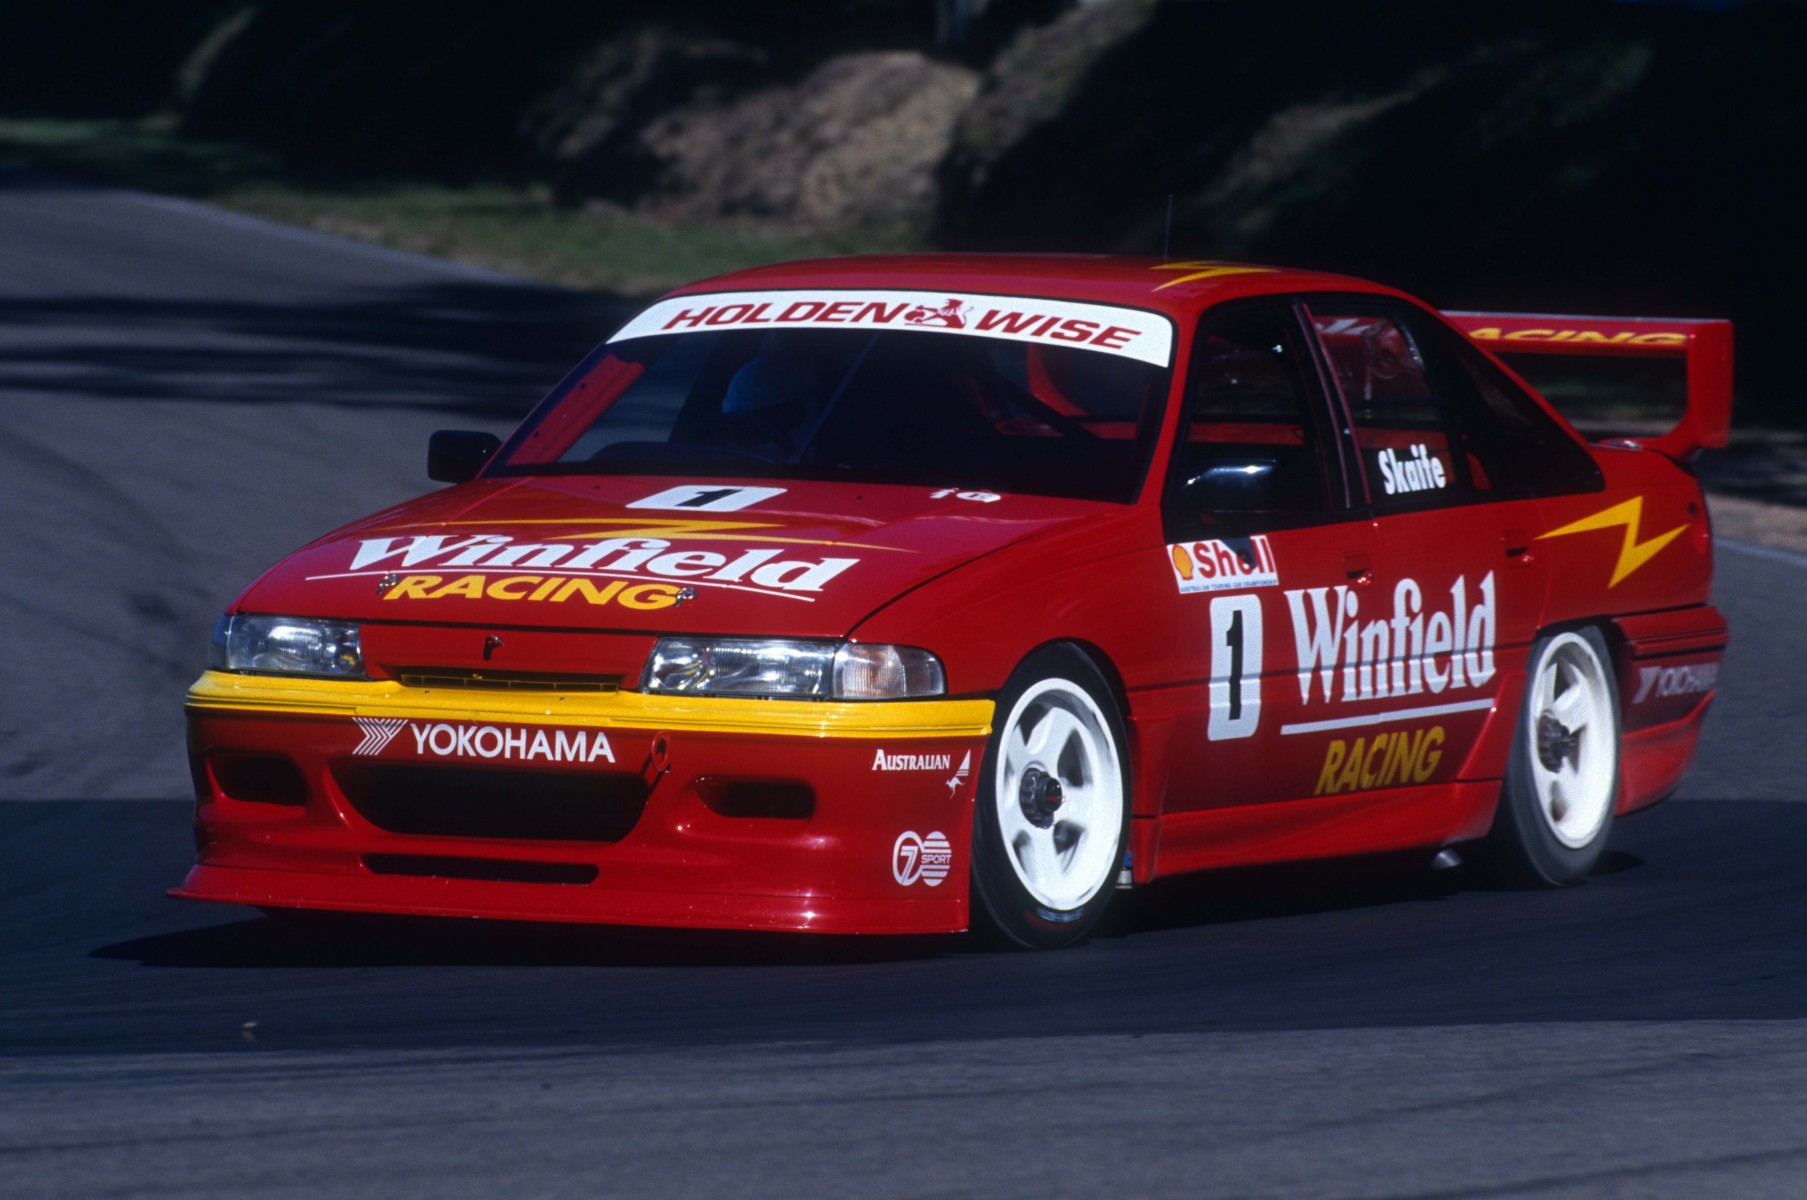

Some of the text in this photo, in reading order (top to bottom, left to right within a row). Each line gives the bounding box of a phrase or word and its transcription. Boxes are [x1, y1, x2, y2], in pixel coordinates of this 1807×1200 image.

[662, 301, 1142, 349] HOLDEN WISE
[1469, 328, 1688, 346] ACING
[1378, 443, 1446, 495] Skaife
[687, 488, 745, 507] 1
[349, 534, 861, 592] Winfield
[1193, 538, 1275, 579] Shell
[383, 575, 682, 611] RACING
[1283, 569, 1497, 705] Winfield
[1226, 609, 1243, 721] 1
[410, 723, 617, 763] YOKOHAMA
[871, 748, 951, 771] AUSTRALIAN
[1313, 725, 1445, 796] RACING
[921, 854, 952, 865] SPORT
